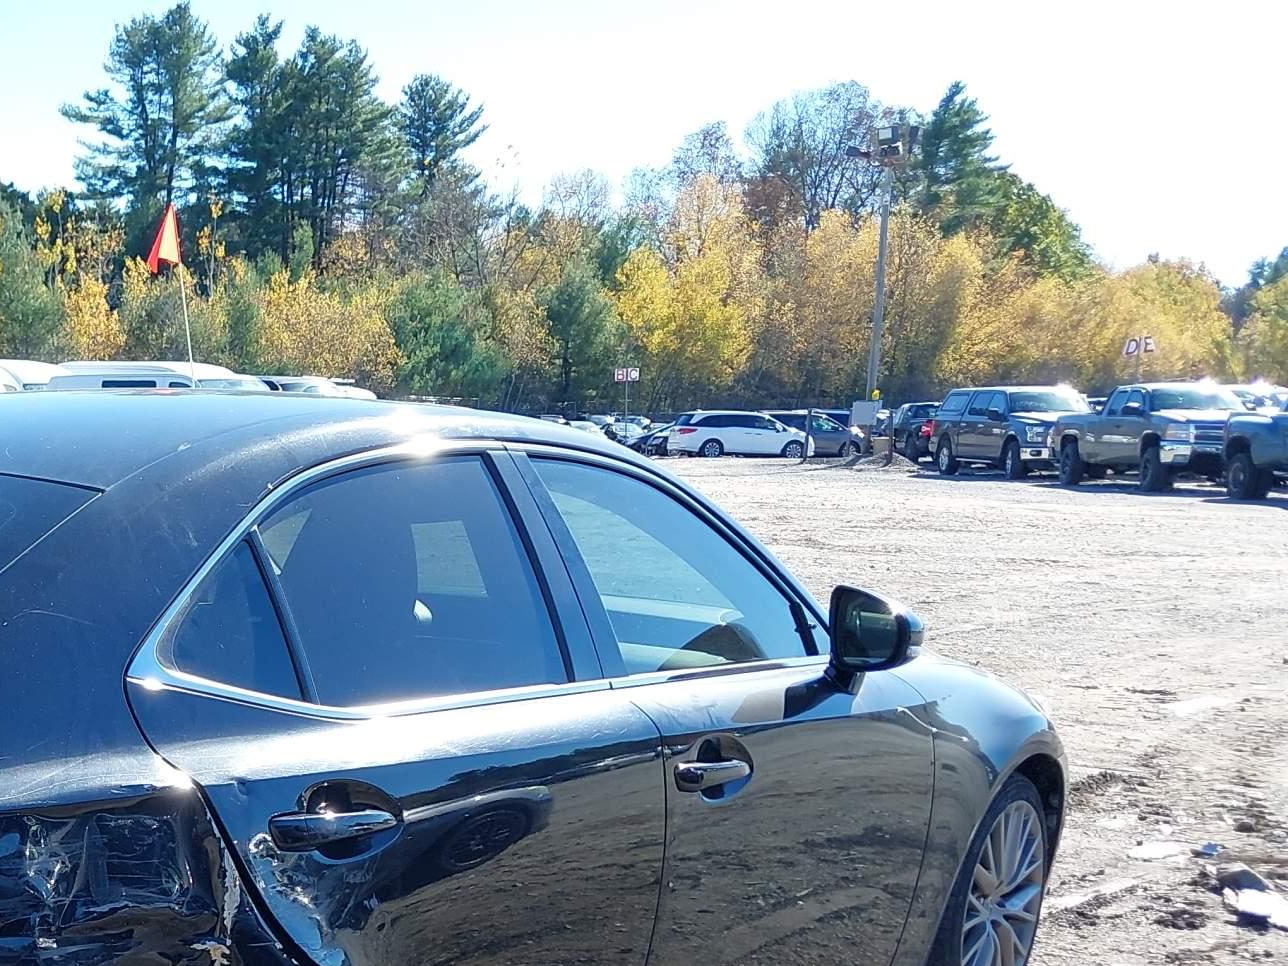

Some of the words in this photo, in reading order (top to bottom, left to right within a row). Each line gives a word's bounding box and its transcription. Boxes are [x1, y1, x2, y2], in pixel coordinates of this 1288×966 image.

[1125, 338, 1138, 355] D
[1143, 336, 1154, 353] E
[616, 369, 625, 381] B
[629, 369, 638, 380] C
